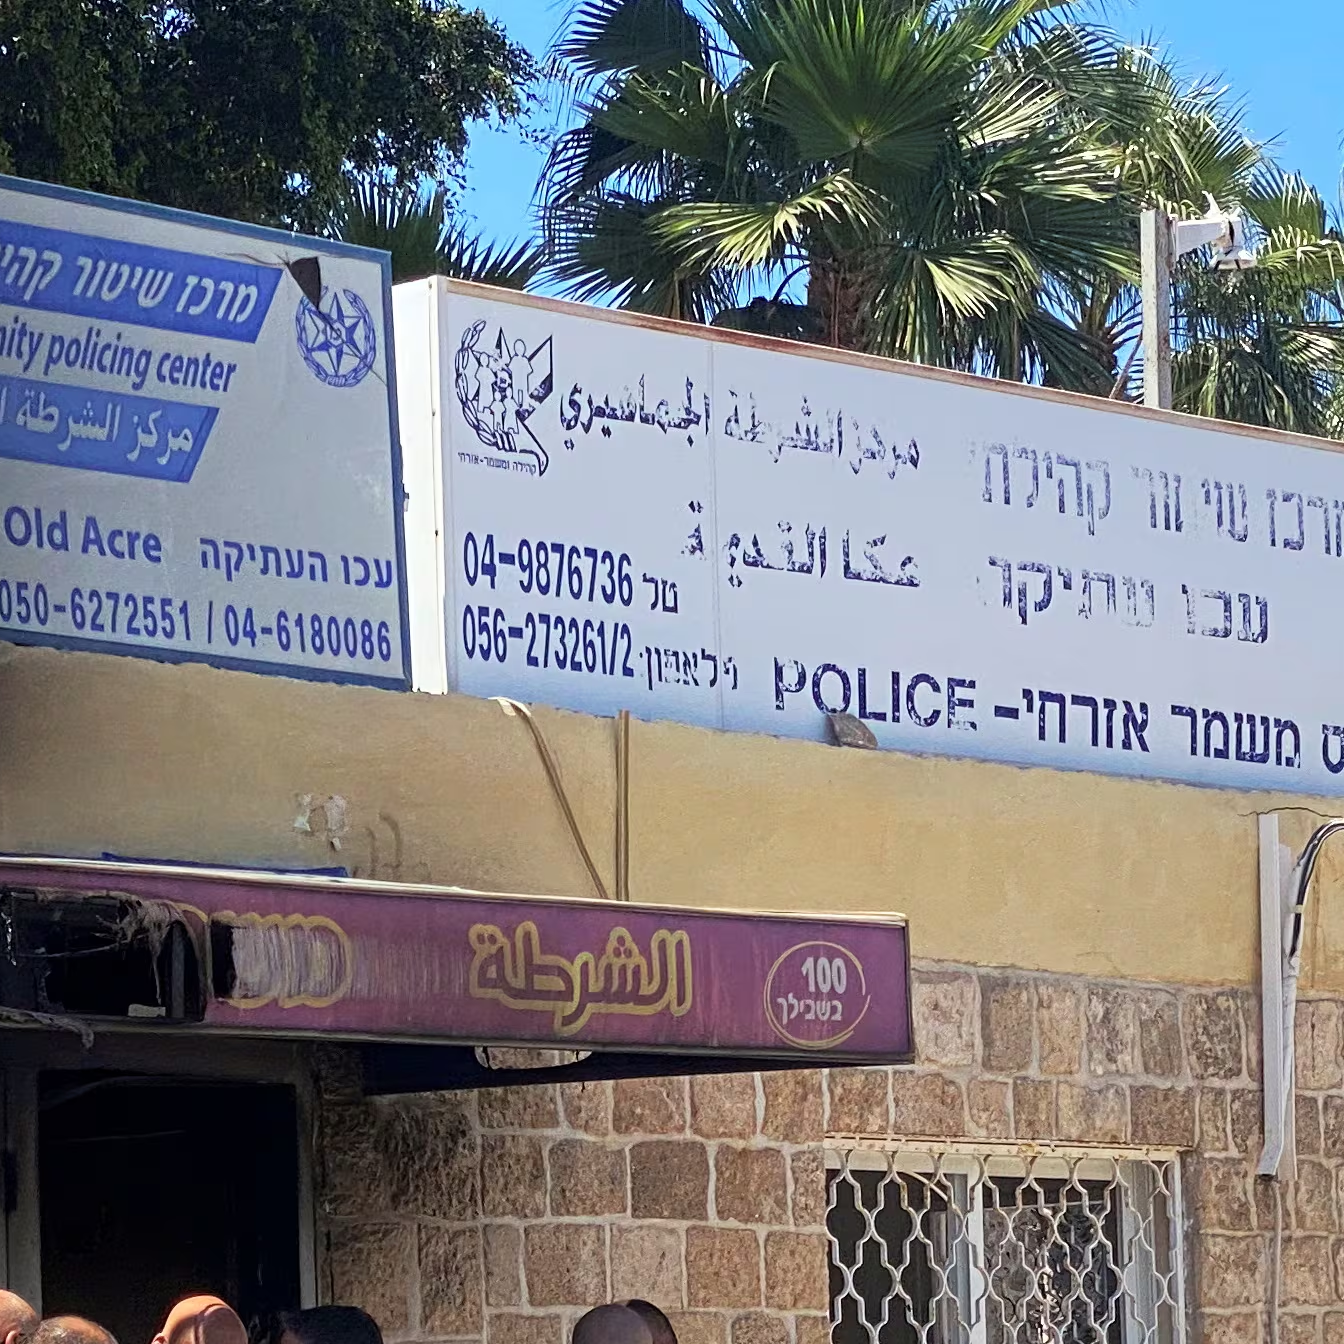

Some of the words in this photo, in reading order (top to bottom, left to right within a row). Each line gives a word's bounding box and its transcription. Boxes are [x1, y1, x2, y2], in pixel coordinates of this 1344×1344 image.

[72, 255, 174, 308] שיטור
[176, 274, 258, 323] מרכז
[44, 326, 152, 390] policing
[156, 350, 237, 393] center
[15, 387, 121, 451] الشرطة
[126, 408, 194, 465] مركز
[3, 506, 70, 552] Old
[80, 516, 163, 563] Acre
[199, 536, 329, 583] העתיקה
[340, 554, 393, 589] עכו
[463, 531, 634, 607] 04-9876736
[224, 605, 392, 662] 04-6180086
[462, 604, 635, 678] 056-273261/2
[773, 656, 978, 732] POLICE
[1170, 704, 1301, 769] משמר
[468, 919, 693, 1036] الشرطة
[801, 956, 847, 995] 100
[776, 992, 843, 1026] בשבילך
